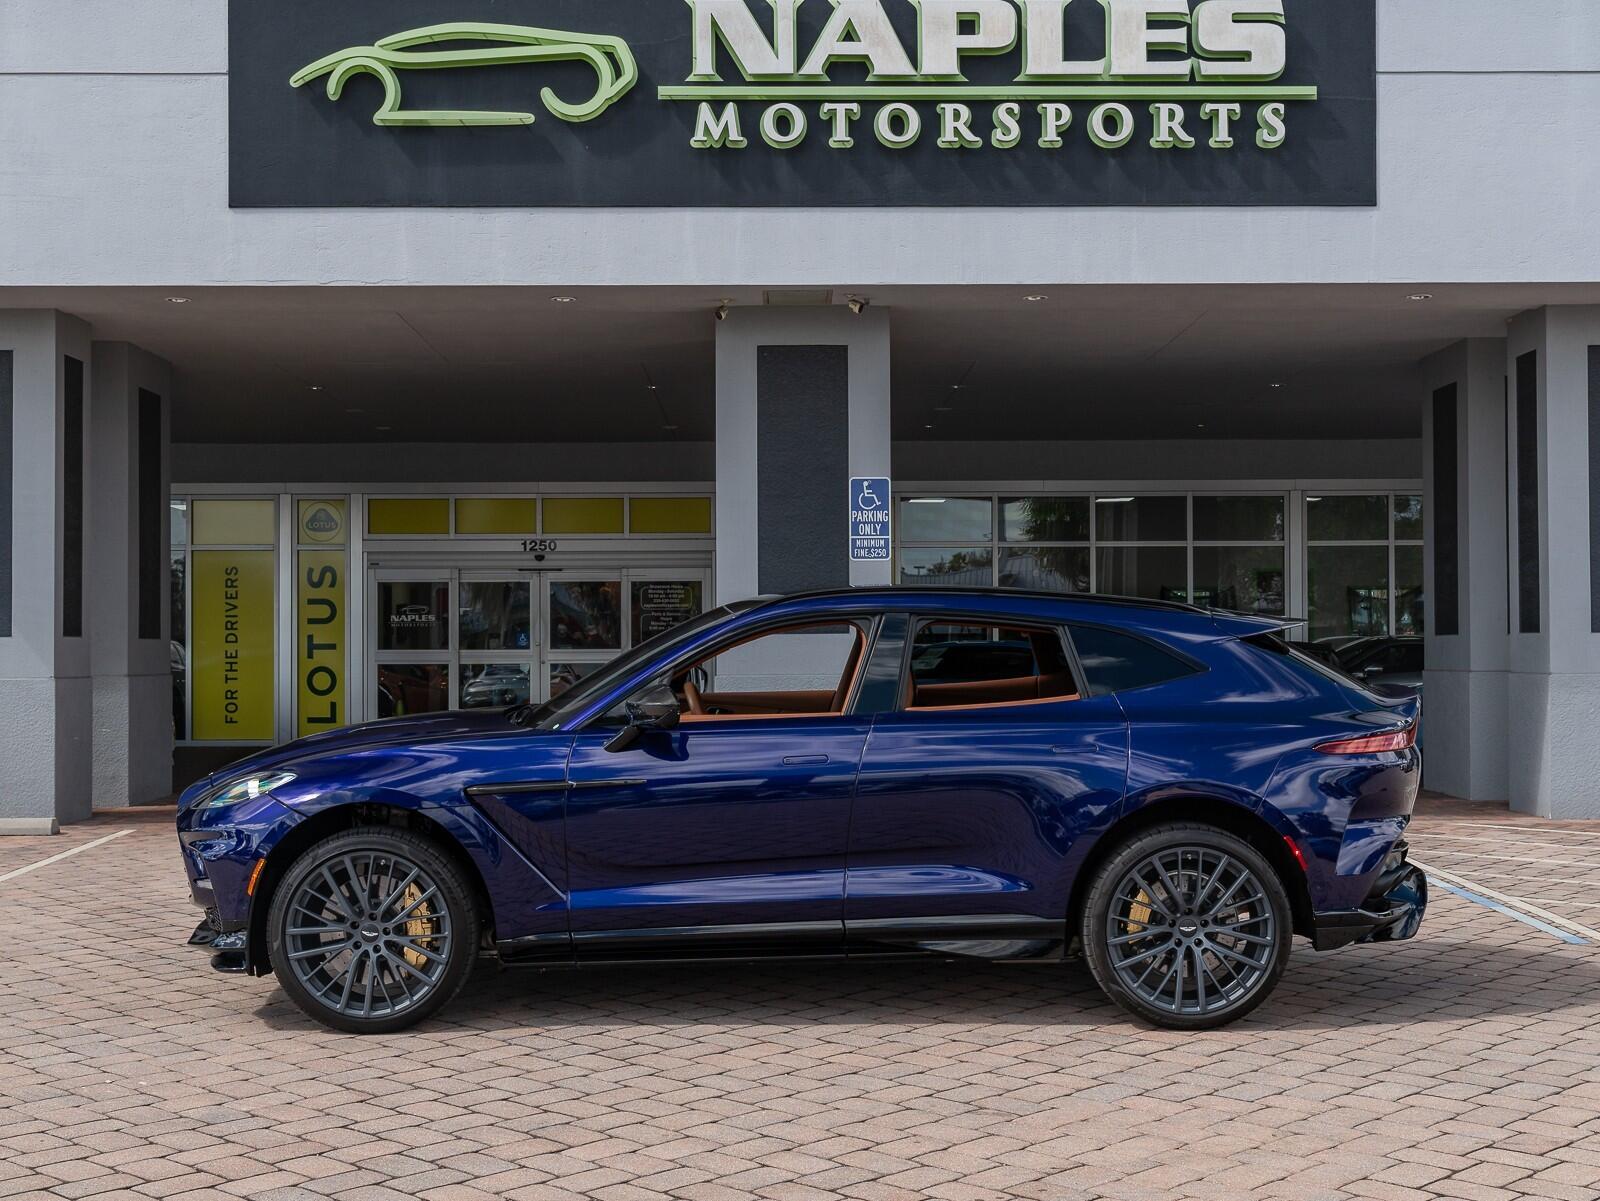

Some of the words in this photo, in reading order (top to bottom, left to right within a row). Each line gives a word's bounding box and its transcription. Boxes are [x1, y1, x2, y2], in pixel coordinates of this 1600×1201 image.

[684, 0, 1287, 83] NAPLES
[690, 101, 1287, 149] MOTORSPORTS
[308, 521, 337, 529] LOTUS
[851, 510, 889, 522] PARKING
[858, 523, 882, 535] ONLY
[520, 540, 557, 552] 1250
[854, 548, 869, 557] FINE
[870, 548, 887, 558] $250
[856, 538, 885, 548] MINIMUM
[224, 565, 239, 644] DRIVERS
[306, 564, 337, 724] LOTUS
[224, 649, 239, 684] THE
[224, 688, 239, 724] FOR
